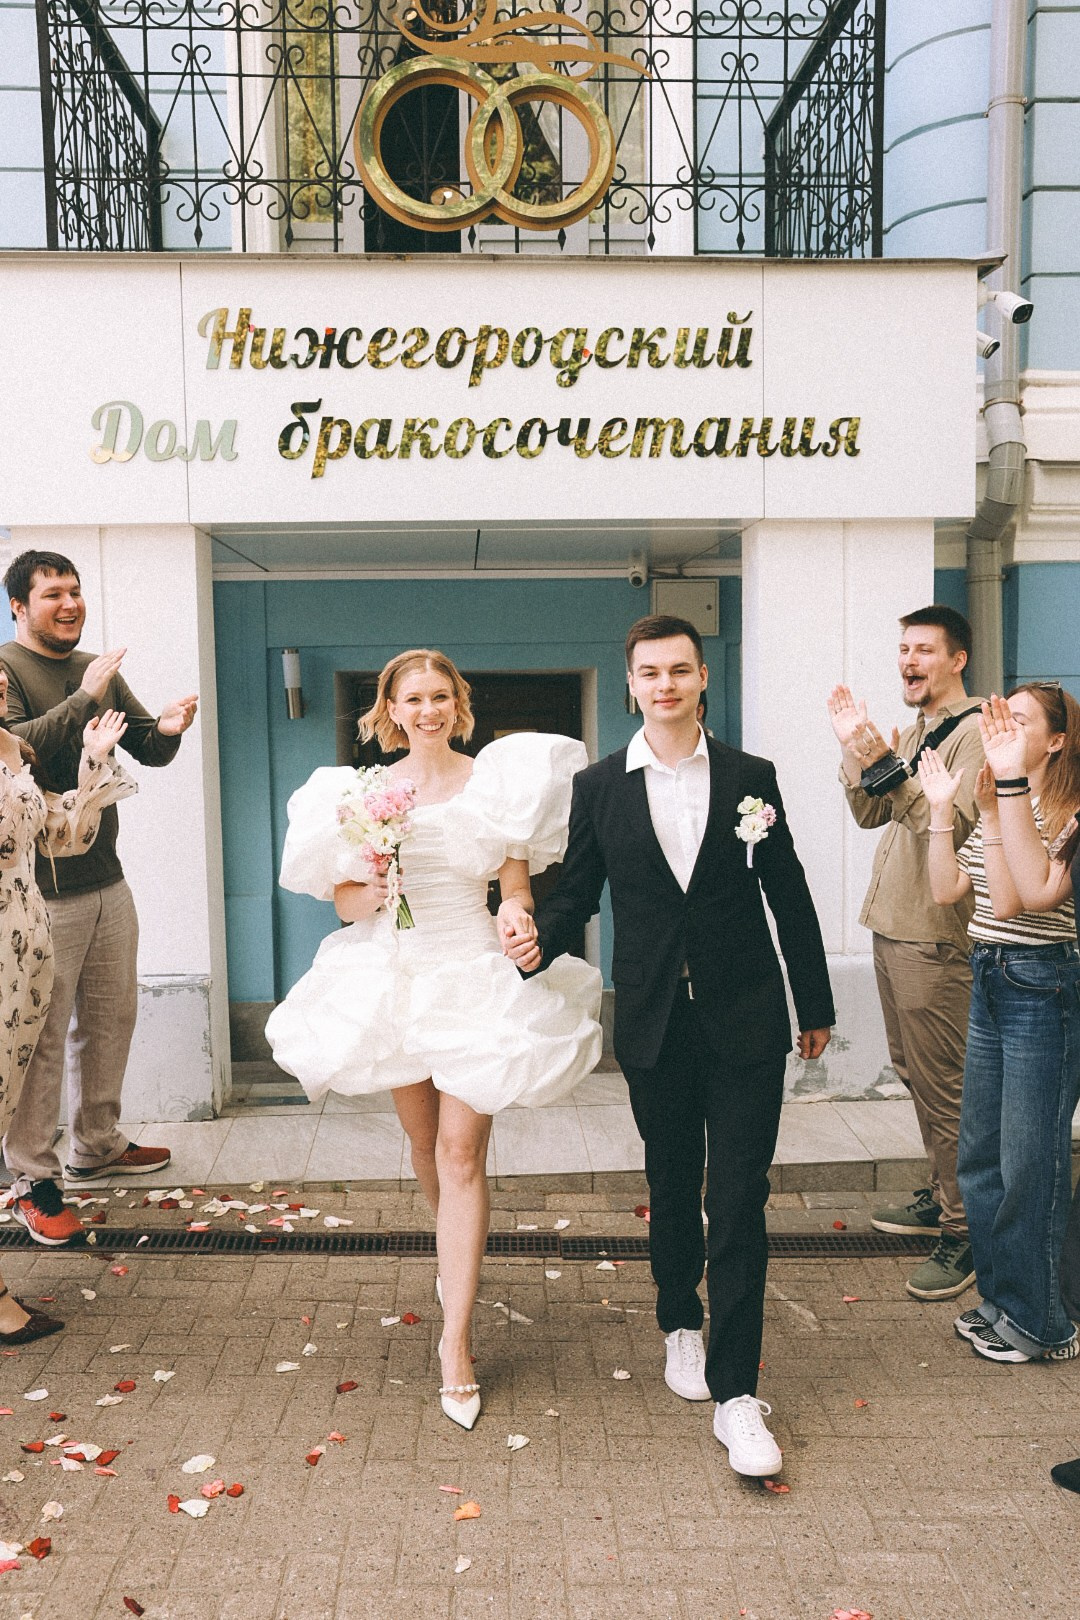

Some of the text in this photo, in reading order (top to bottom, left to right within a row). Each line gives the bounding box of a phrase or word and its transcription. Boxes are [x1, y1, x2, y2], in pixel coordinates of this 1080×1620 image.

[197, 307, 753, 388] Нижегородский
[89, 397, 861, 479] Дом бракосочетания
